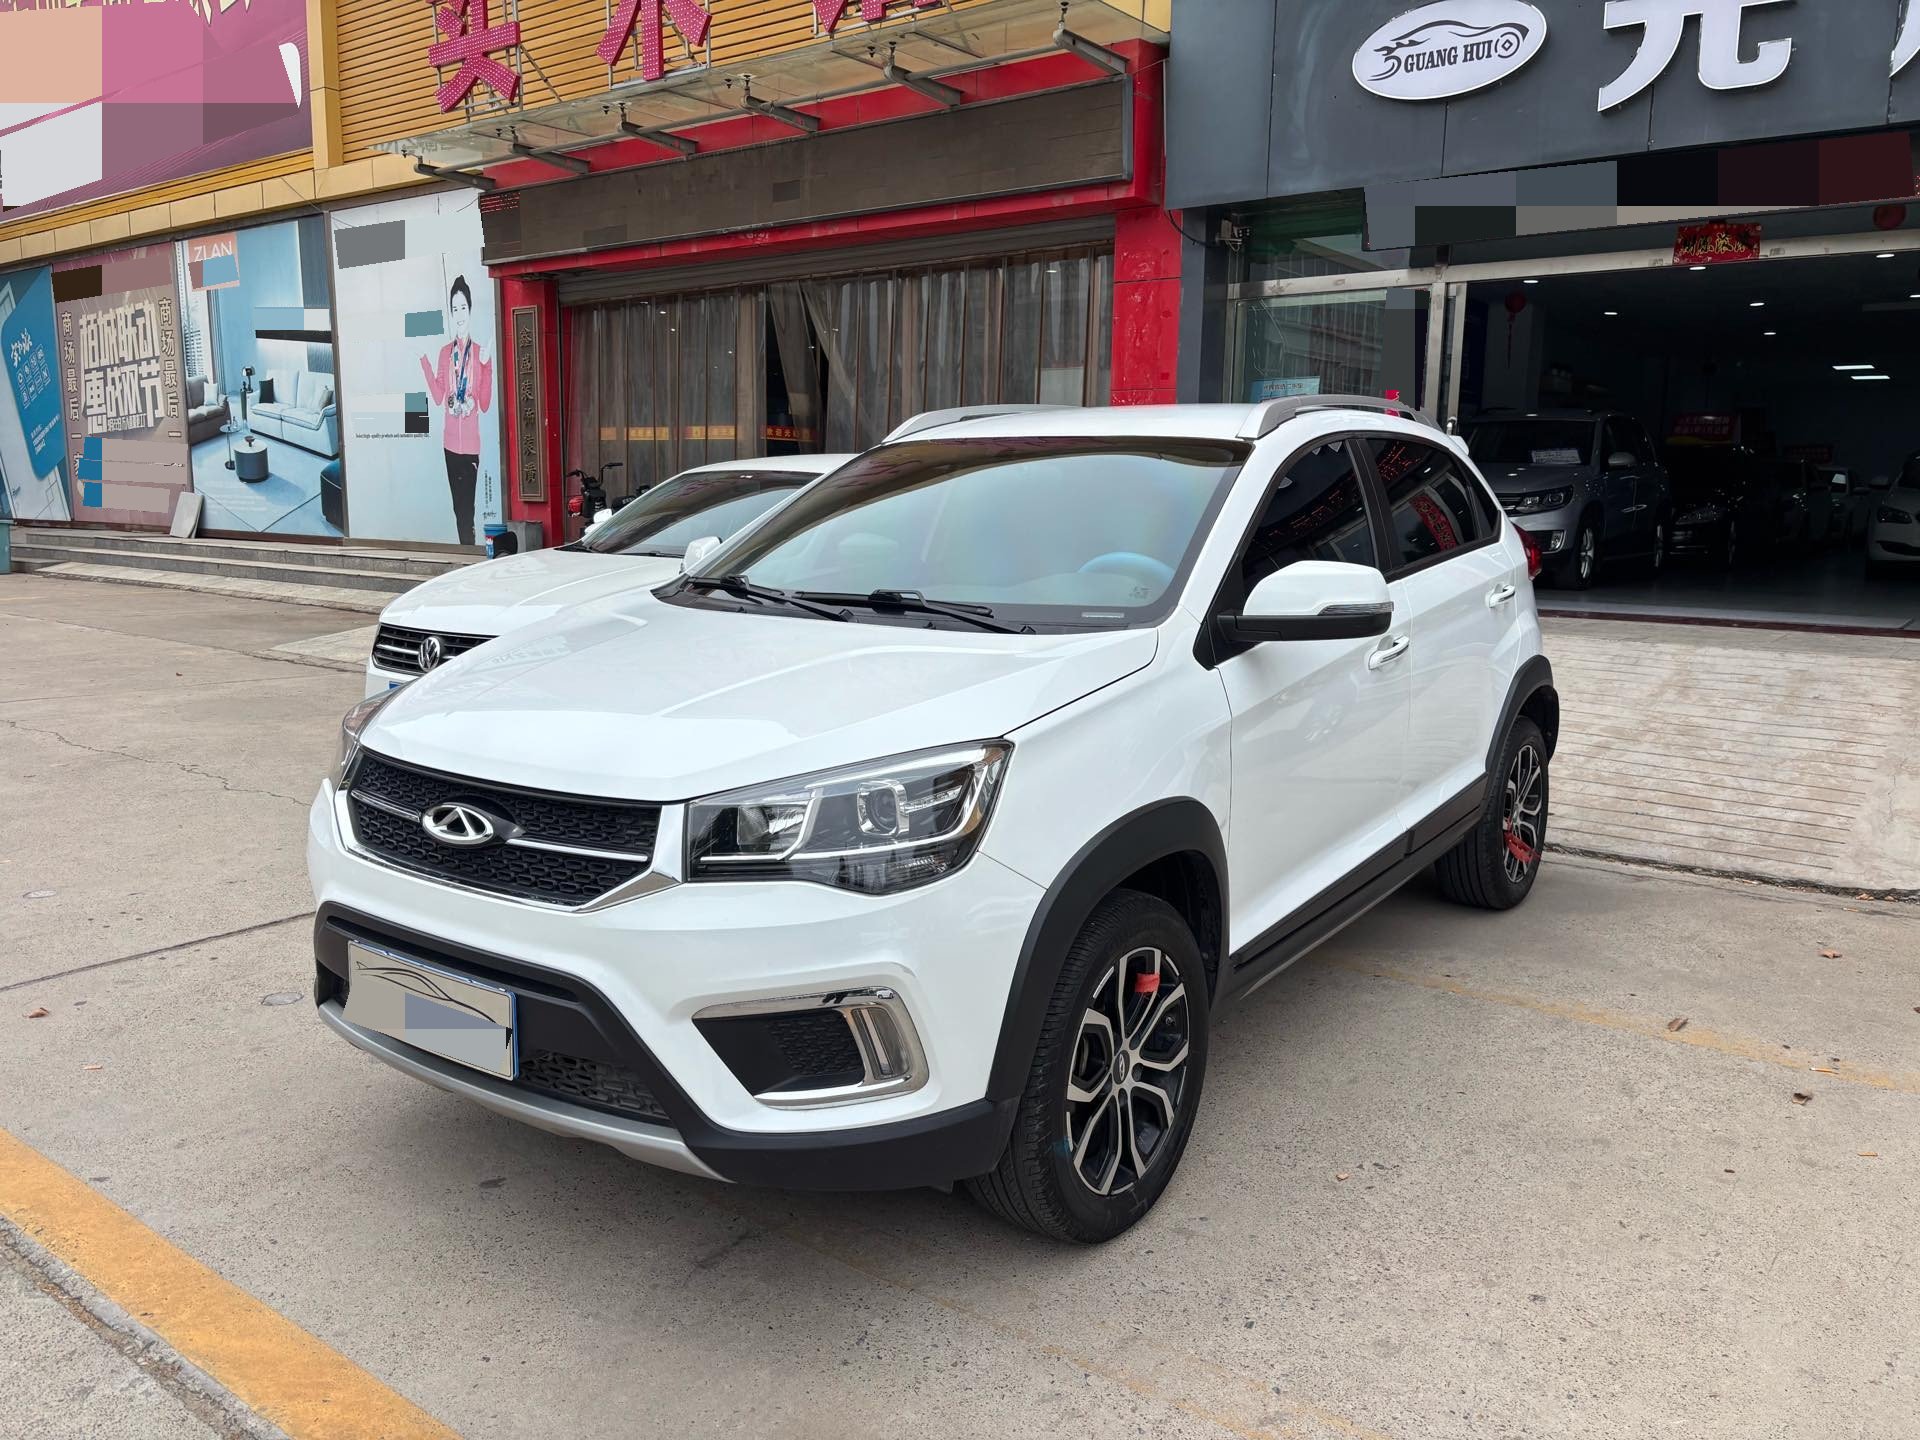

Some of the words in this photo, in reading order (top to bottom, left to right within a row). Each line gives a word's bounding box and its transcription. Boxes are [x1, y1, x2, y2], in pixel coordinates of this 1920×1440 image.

[1403, 46, 1459, 74] GUANG
[1462, 39, 1493, 65] HUI
[158, 297, 184, 468] 商场最后一
